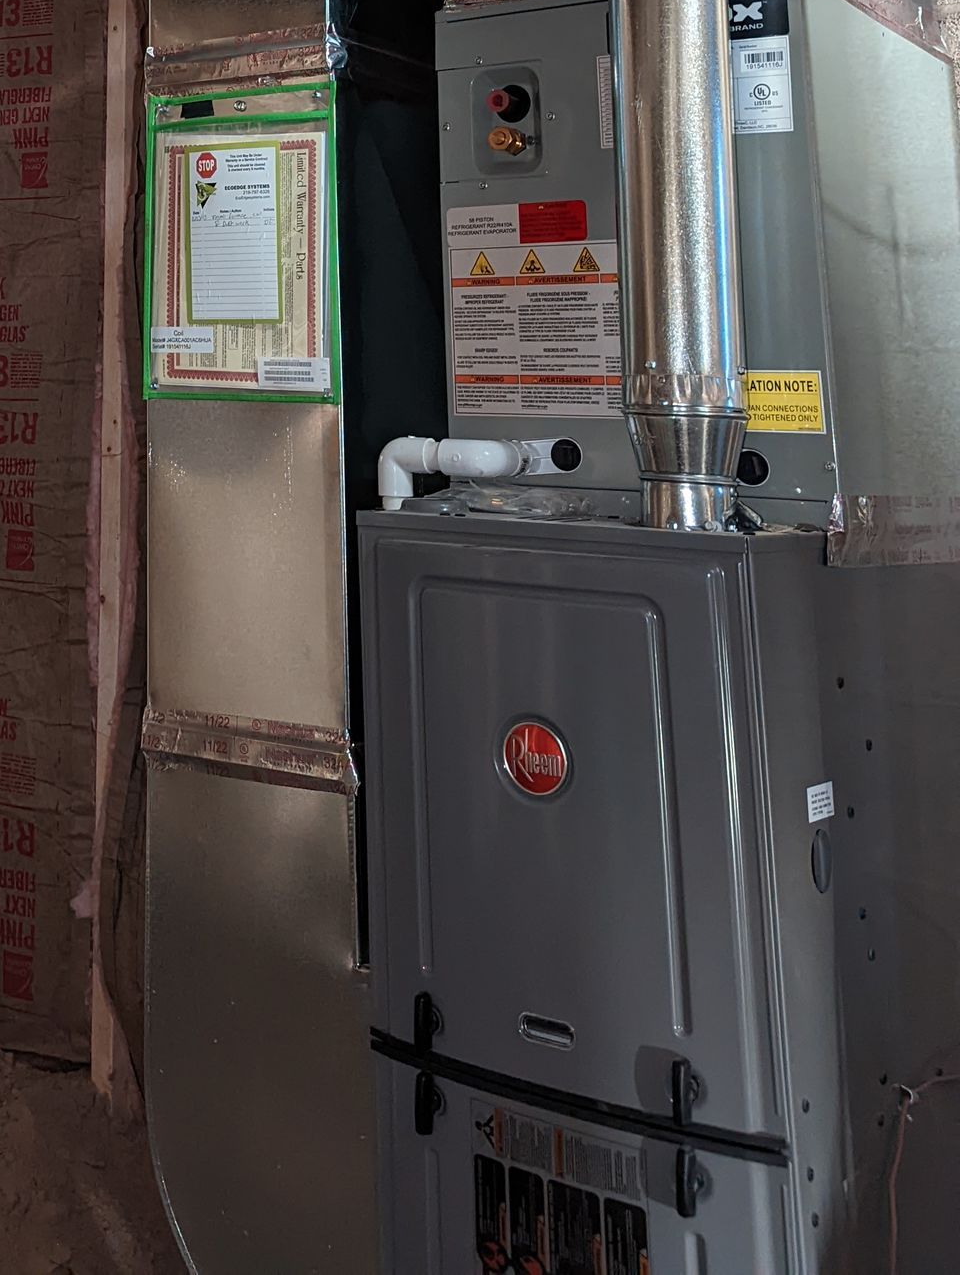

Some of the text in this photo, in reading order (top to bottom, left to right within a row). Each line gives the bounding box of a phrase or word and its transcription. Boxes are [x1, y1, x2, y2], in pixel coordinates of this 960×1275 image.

[7, 45, 52, 77] R13
[22, 107, 50, 123] NEXT
[198, 159, 215, 172] STOP
[293, 152, 306, 280] Limited Warranty Parts
[747, 380, 817, 392] ATION NOTE:
[762, 405, 819, 413] CONNECTIONS
[753, 414, 797, 422] TIGHTENED
[4, 480, 35, 498] NEXT
[1, 501, 34, 525] PINK
[205, 715, 230, 729] 11/22
[203, 740, 228, 754] 11/22
[510, 728, 562, 782] Rheem
[2, 895, 35, 919] NEXT
